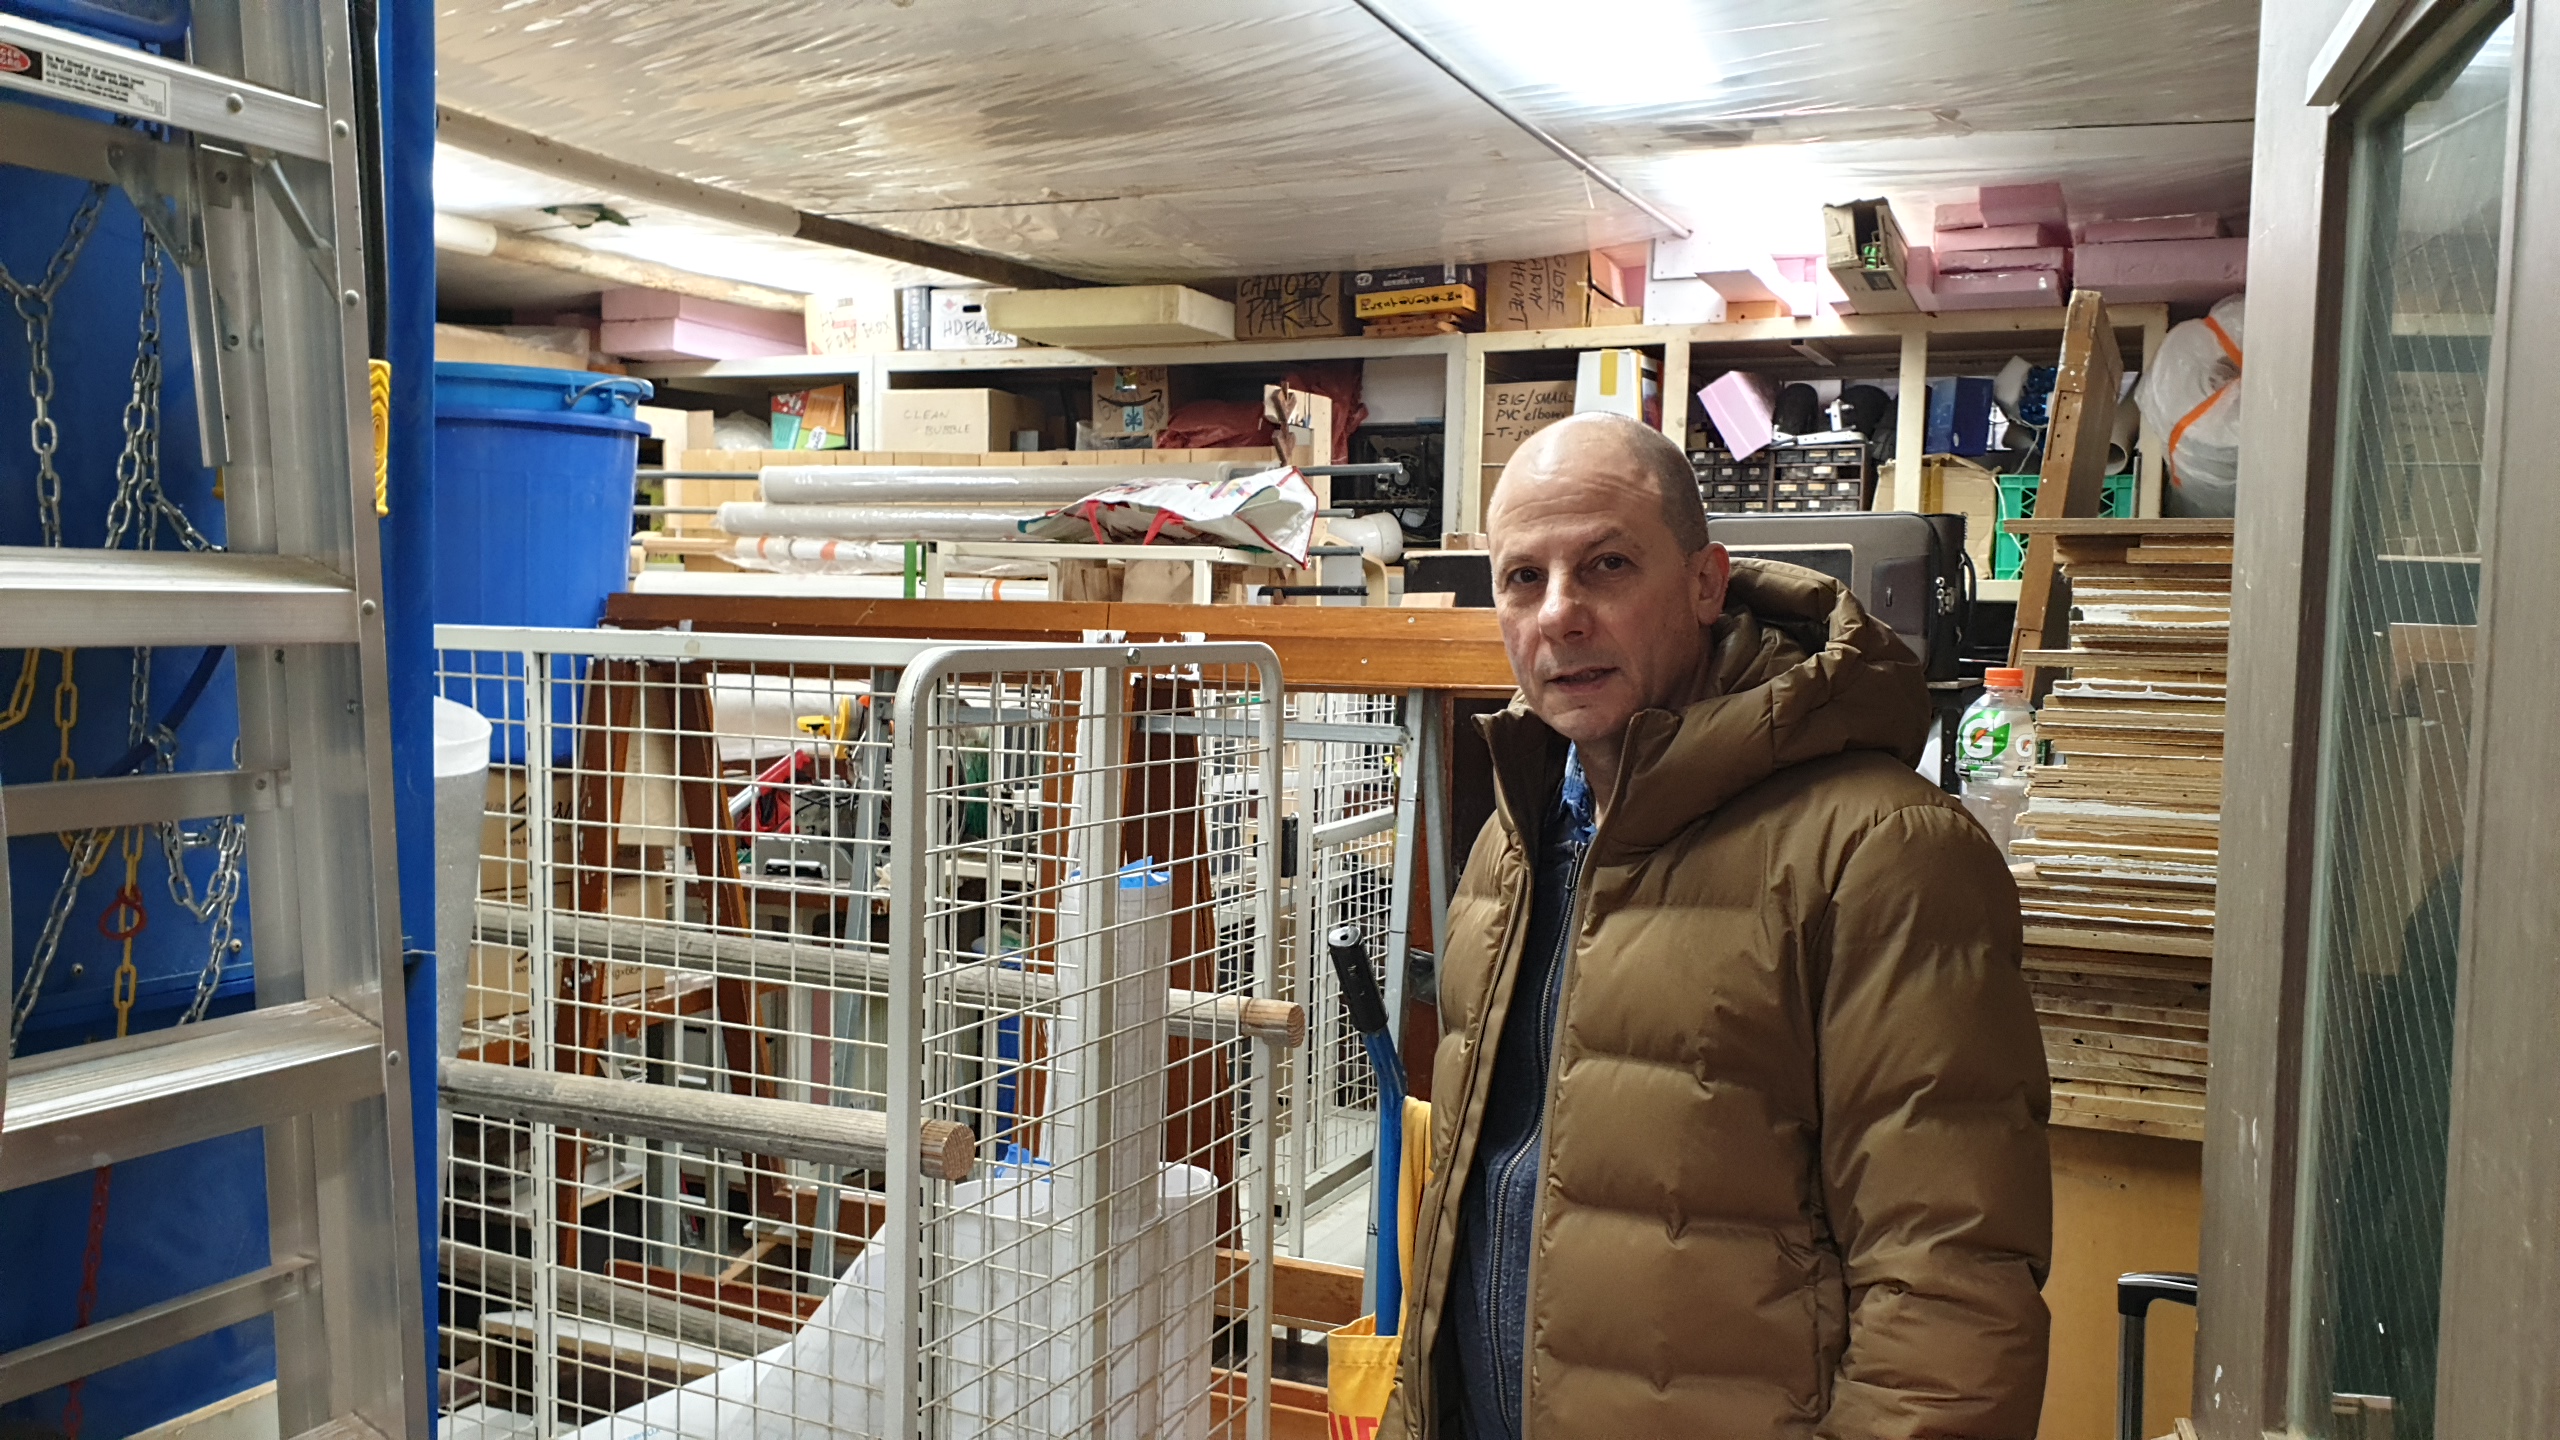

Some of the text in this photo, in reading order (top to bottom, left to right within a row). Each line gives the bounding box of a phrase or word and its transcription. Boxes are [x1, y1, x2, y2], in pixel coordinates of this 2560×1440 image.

[1241, 272, 1331, 297] CANOPY
[1508, 260, 1528, 330] HELMET
[1246, 294, 1333, 336] PARTS
[903, 409, 950, 420] CLEAN
[1495, 409, 1520, 422] PVC
[924, 423, 972, 436] BUBBLE
